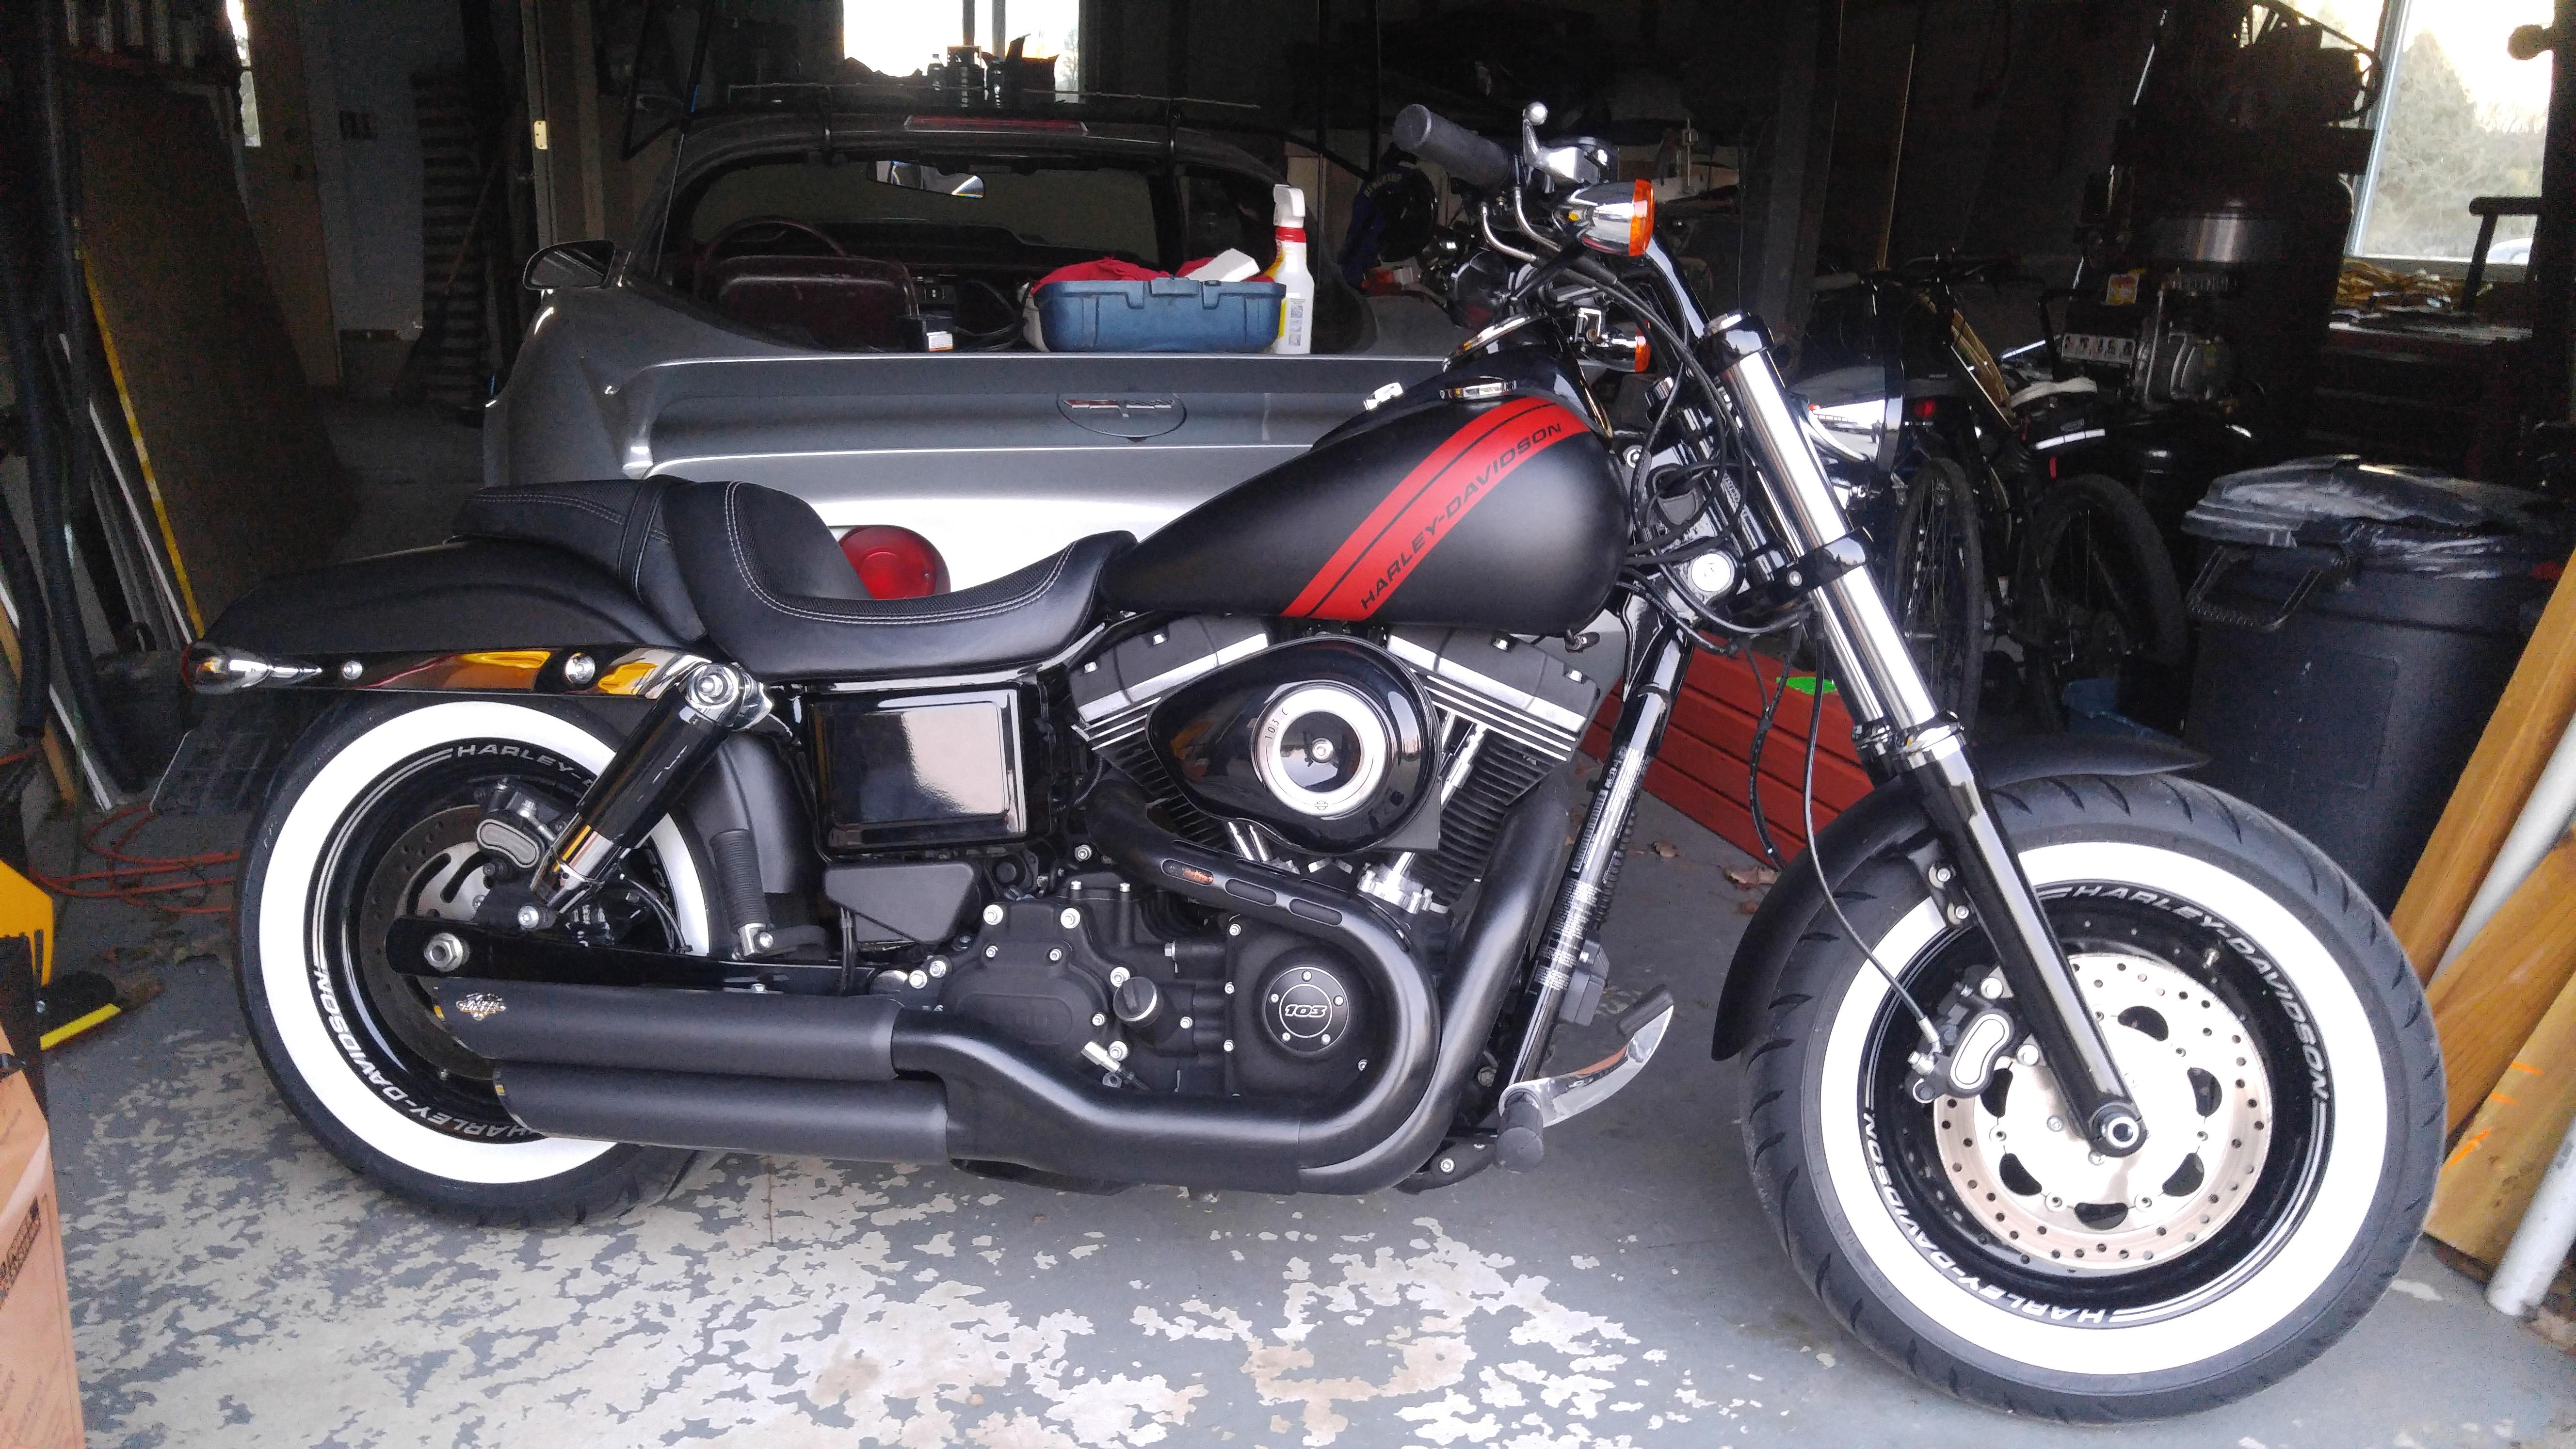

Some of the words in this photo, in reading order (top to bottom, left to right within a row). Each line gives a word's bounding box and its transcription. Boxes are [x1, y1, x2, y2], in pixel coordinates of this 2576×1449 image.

[1361, 423, 1561, 610] HARLEY-DAVIDSON
[1265, 719, 1279, 739] 103
[314, 970, 529, 1137] HARLEY-DAVIDSON
[1285, 1004, 1327, 1017] 103
[2072, 886, 2329, 1100] HARLEY-DAVIDSON
[1864, 1112, 2106, 1323] HARLEY-DAVIDSON
